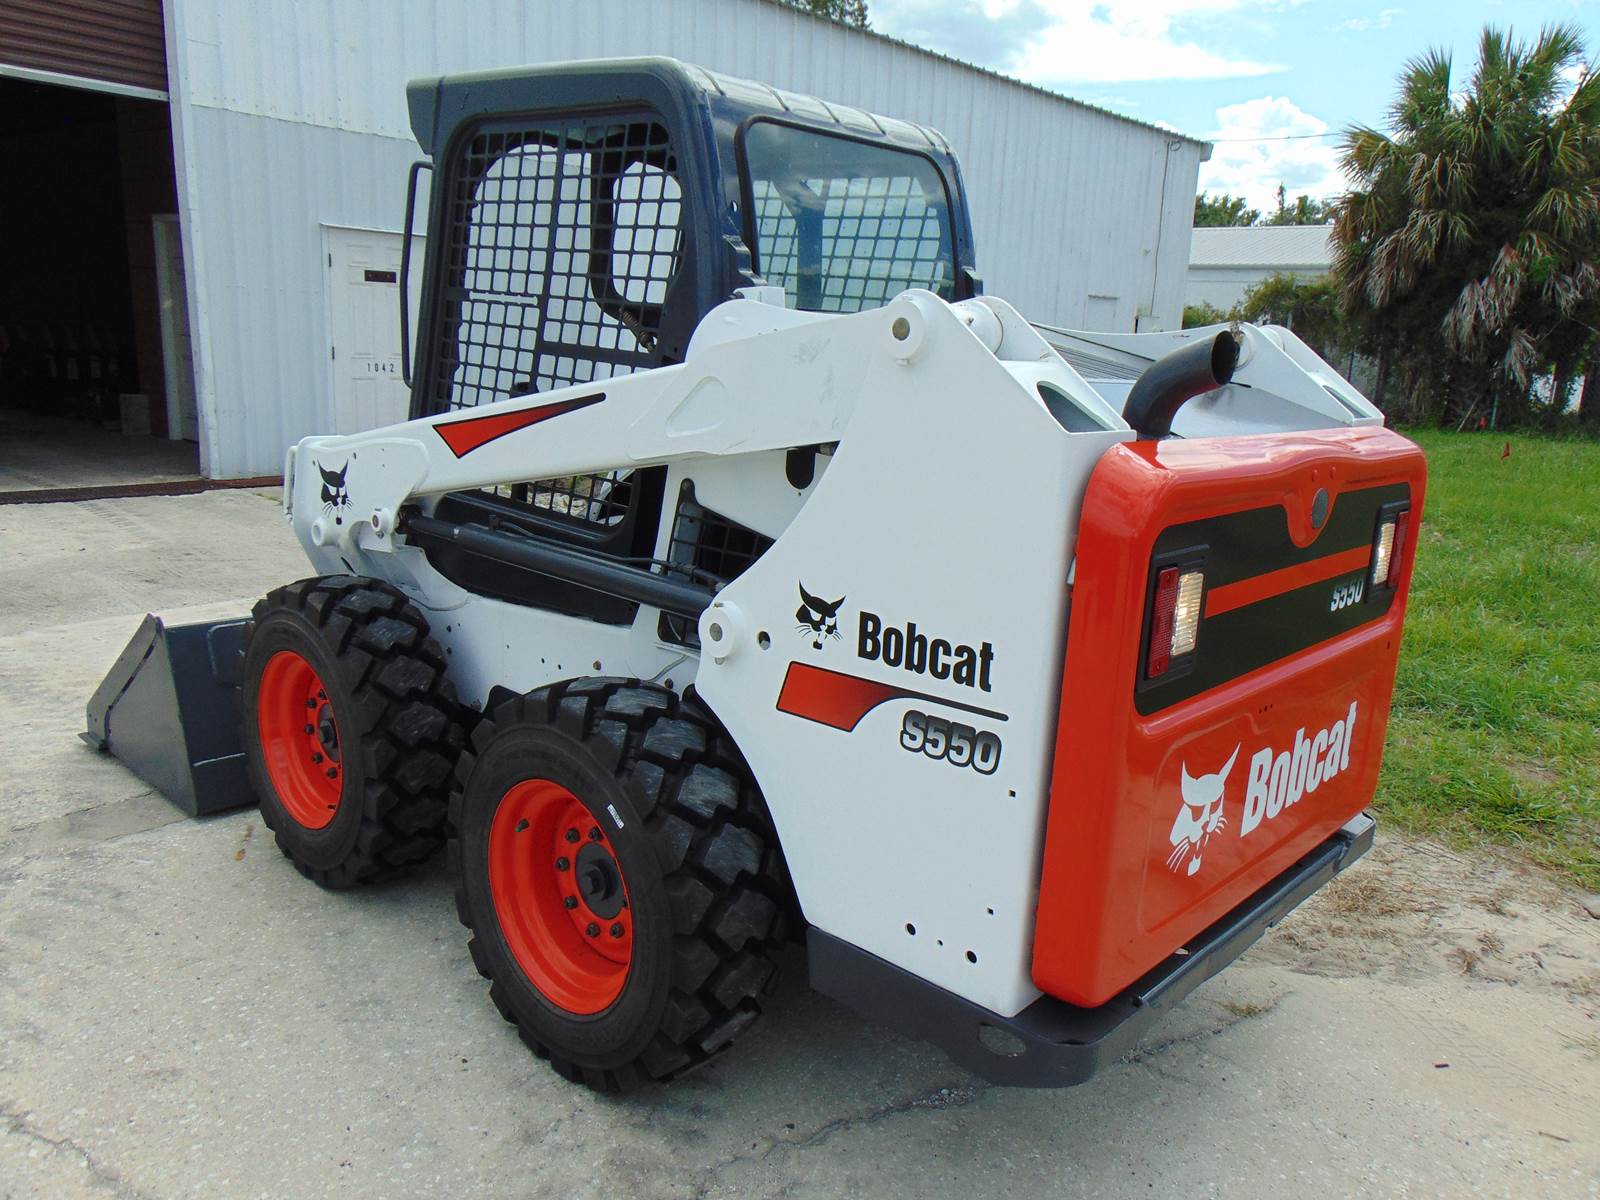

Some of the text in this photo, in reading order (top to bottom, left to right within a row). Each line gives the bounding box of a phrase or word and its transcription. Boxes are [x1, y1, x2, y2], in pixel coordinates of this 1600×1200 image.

[367, 362, 395, 373] 1042
[1330, 578, 1364, 612] S550
[857, 611, 994, 693] Bobcat
[900, 709, 1002, 776] S550
[1240, 700, 1358, 838] Bobcat
